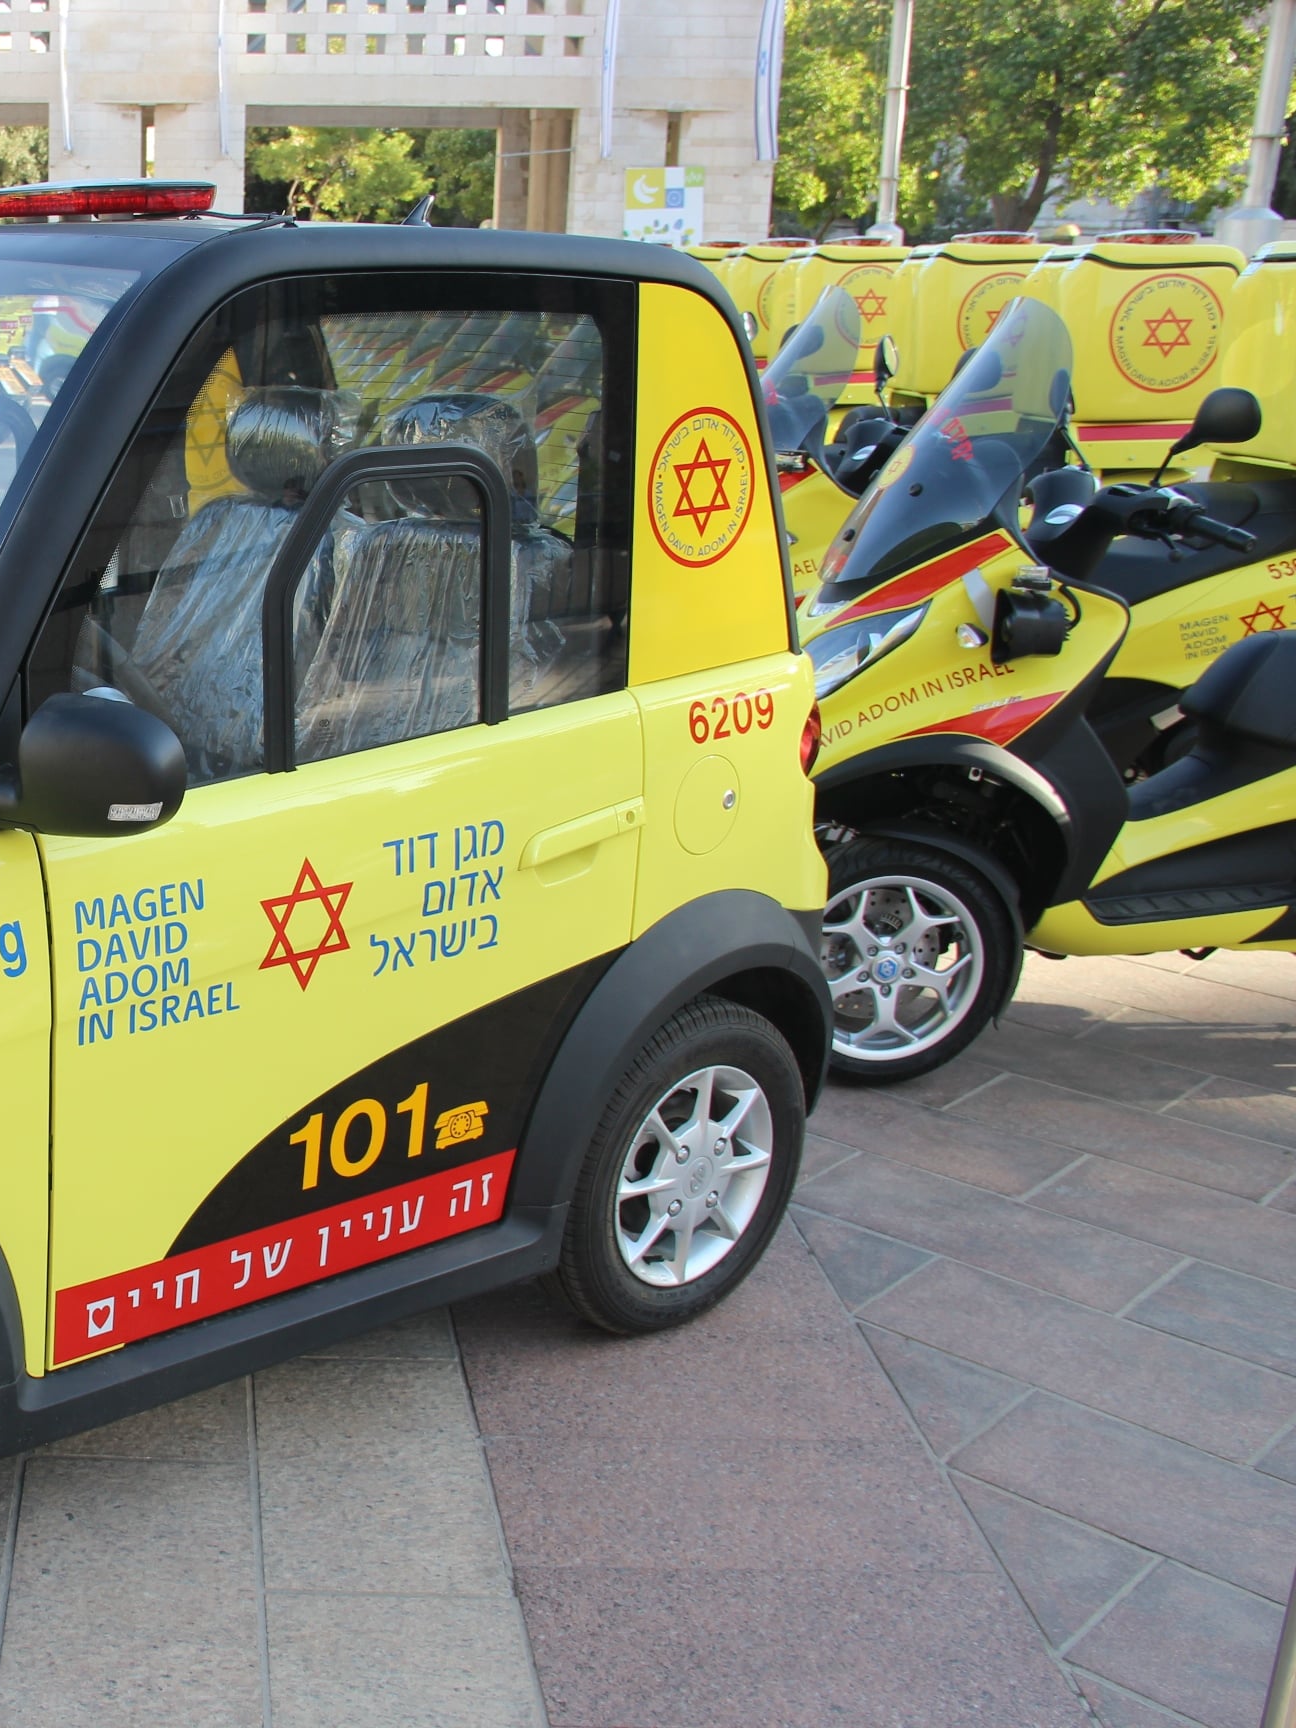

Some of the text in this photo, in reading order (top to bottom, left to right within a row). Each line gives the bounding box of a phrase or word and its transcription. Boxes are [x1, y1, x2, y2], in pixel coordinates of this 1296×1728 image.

[1130, 369, 1157, 386] DAVID
[1157, 372, 1189, 387] ADOM
[657, 417, 745, 473] מגן דוד אדום בישראל
[655, 471, 749, 557] MAGEN DAVID ADOM IN ISRAEL
[1179, 614, 1230, 631] MAGEN
[1181, 627, 1218, 641] DAVID
[1185, 635, 1227, 650] ADOM
[687, 687, 775, 745] 6209
[817, 663, 1015, 749] AVID ADOM IN ISRAEL
[382, 819, 506, 877] מגן דוד
[74, 878, 206, 935] MAGEN
[421, 865, 506, 918] אדום
[76, 921, 189, 973] DAVID
[369, 914, 500, 978] בישראל
[79, 957, 190, 1011] ADOM
[77, 981, 241, 1047] IN ISRAEL
[289, 1081, 430, 1191] 101
[86, 1172, 495, 1339] זה עניין של חיים
